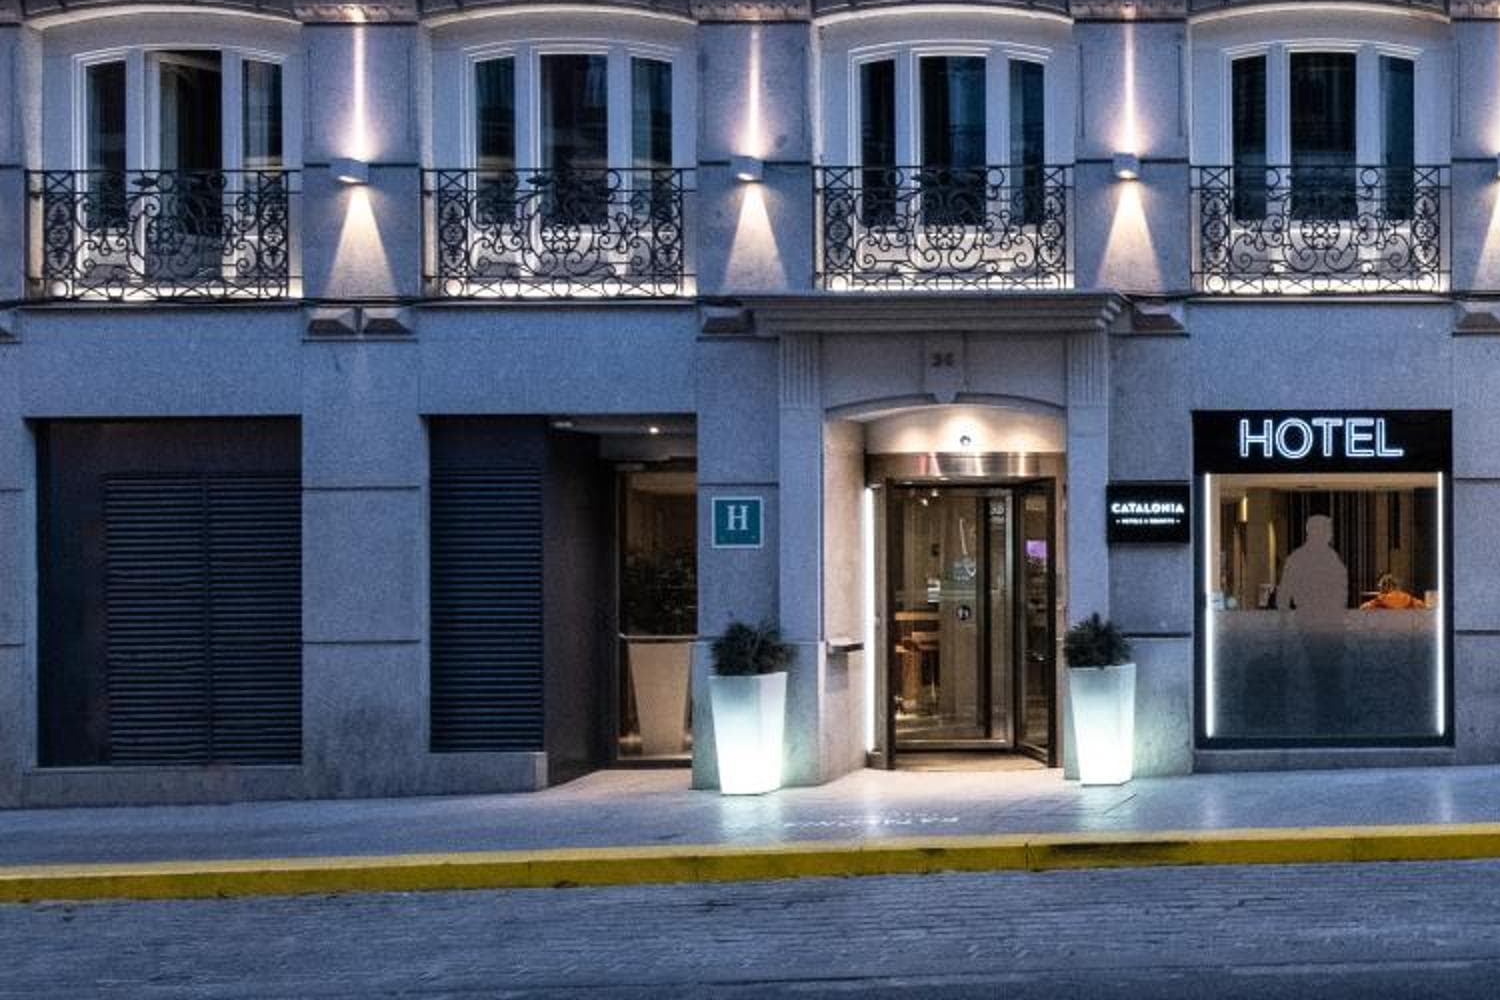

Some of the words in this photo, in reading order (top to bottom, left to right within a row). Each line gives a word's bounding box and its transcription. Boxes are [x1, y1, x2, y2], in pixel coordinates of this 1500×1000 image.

[1239, 417, 1405, 459] HOTEL
[727, 505, 749, 531] H
[1111, 502, 1185, 514] CATALONIA
